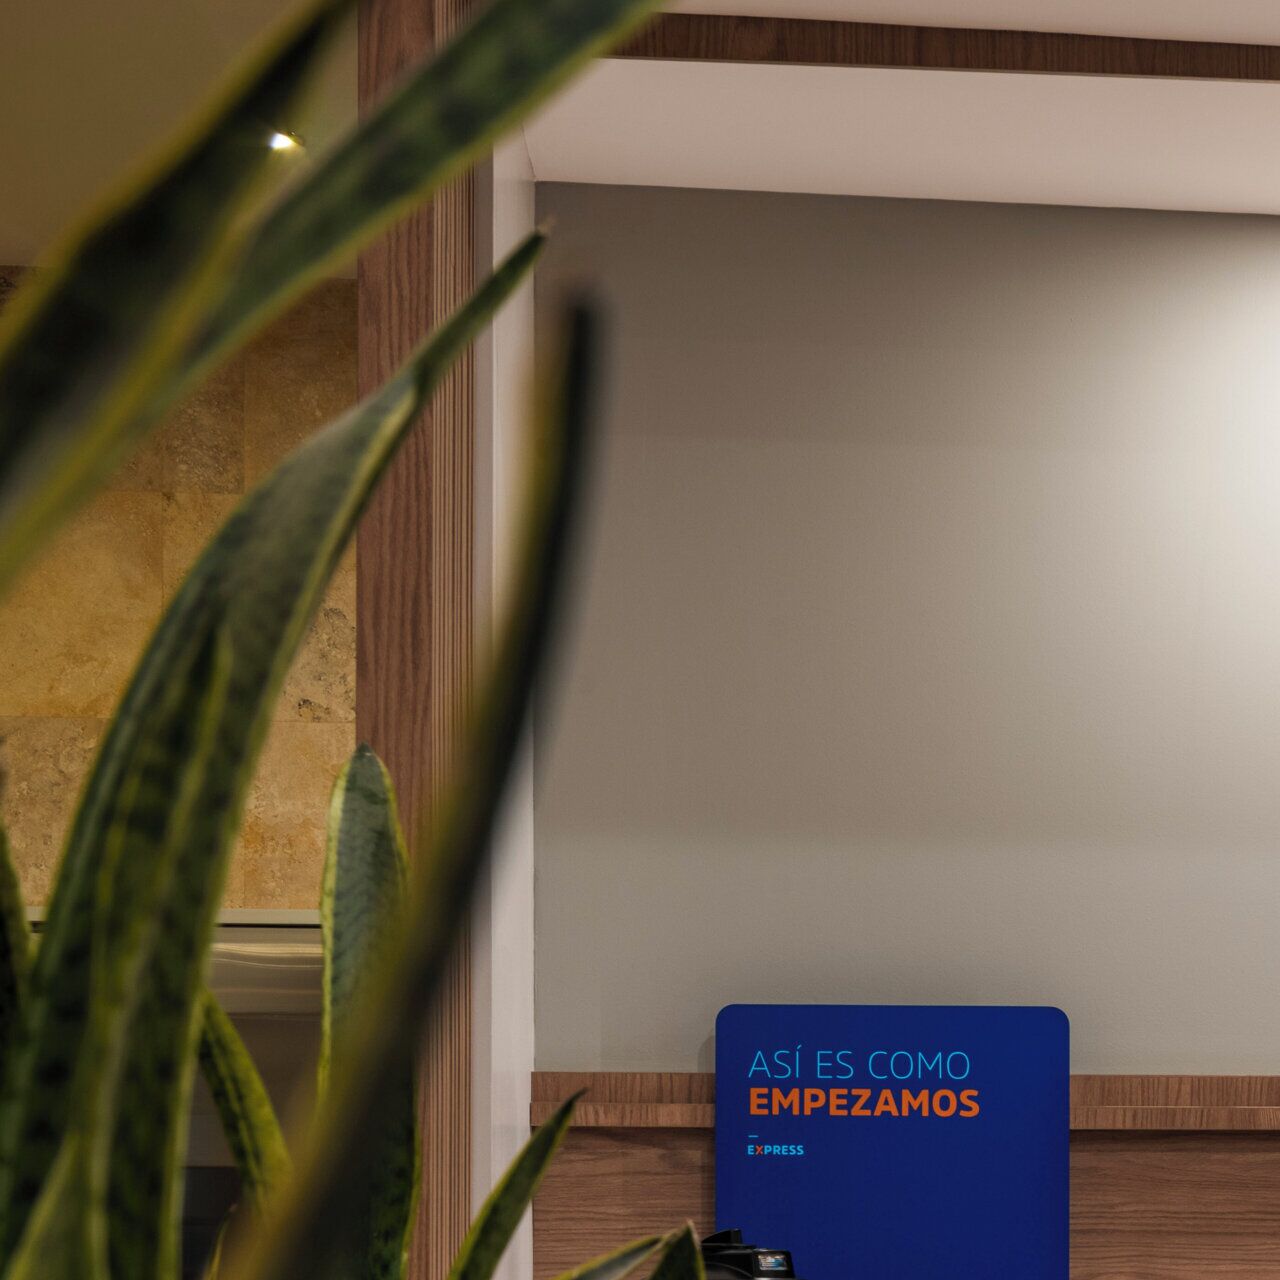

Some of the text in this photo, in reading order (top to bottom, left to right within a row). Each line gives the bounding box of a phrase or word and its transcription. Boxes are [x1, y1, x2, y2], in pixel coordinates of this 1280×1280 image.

[748, 1044, 970, 1080] ASÍ ES COMO
[749, 1087, 981, 1118] EMPEZAMOS
[747, 1145, 804, 1156] EXPRESS
